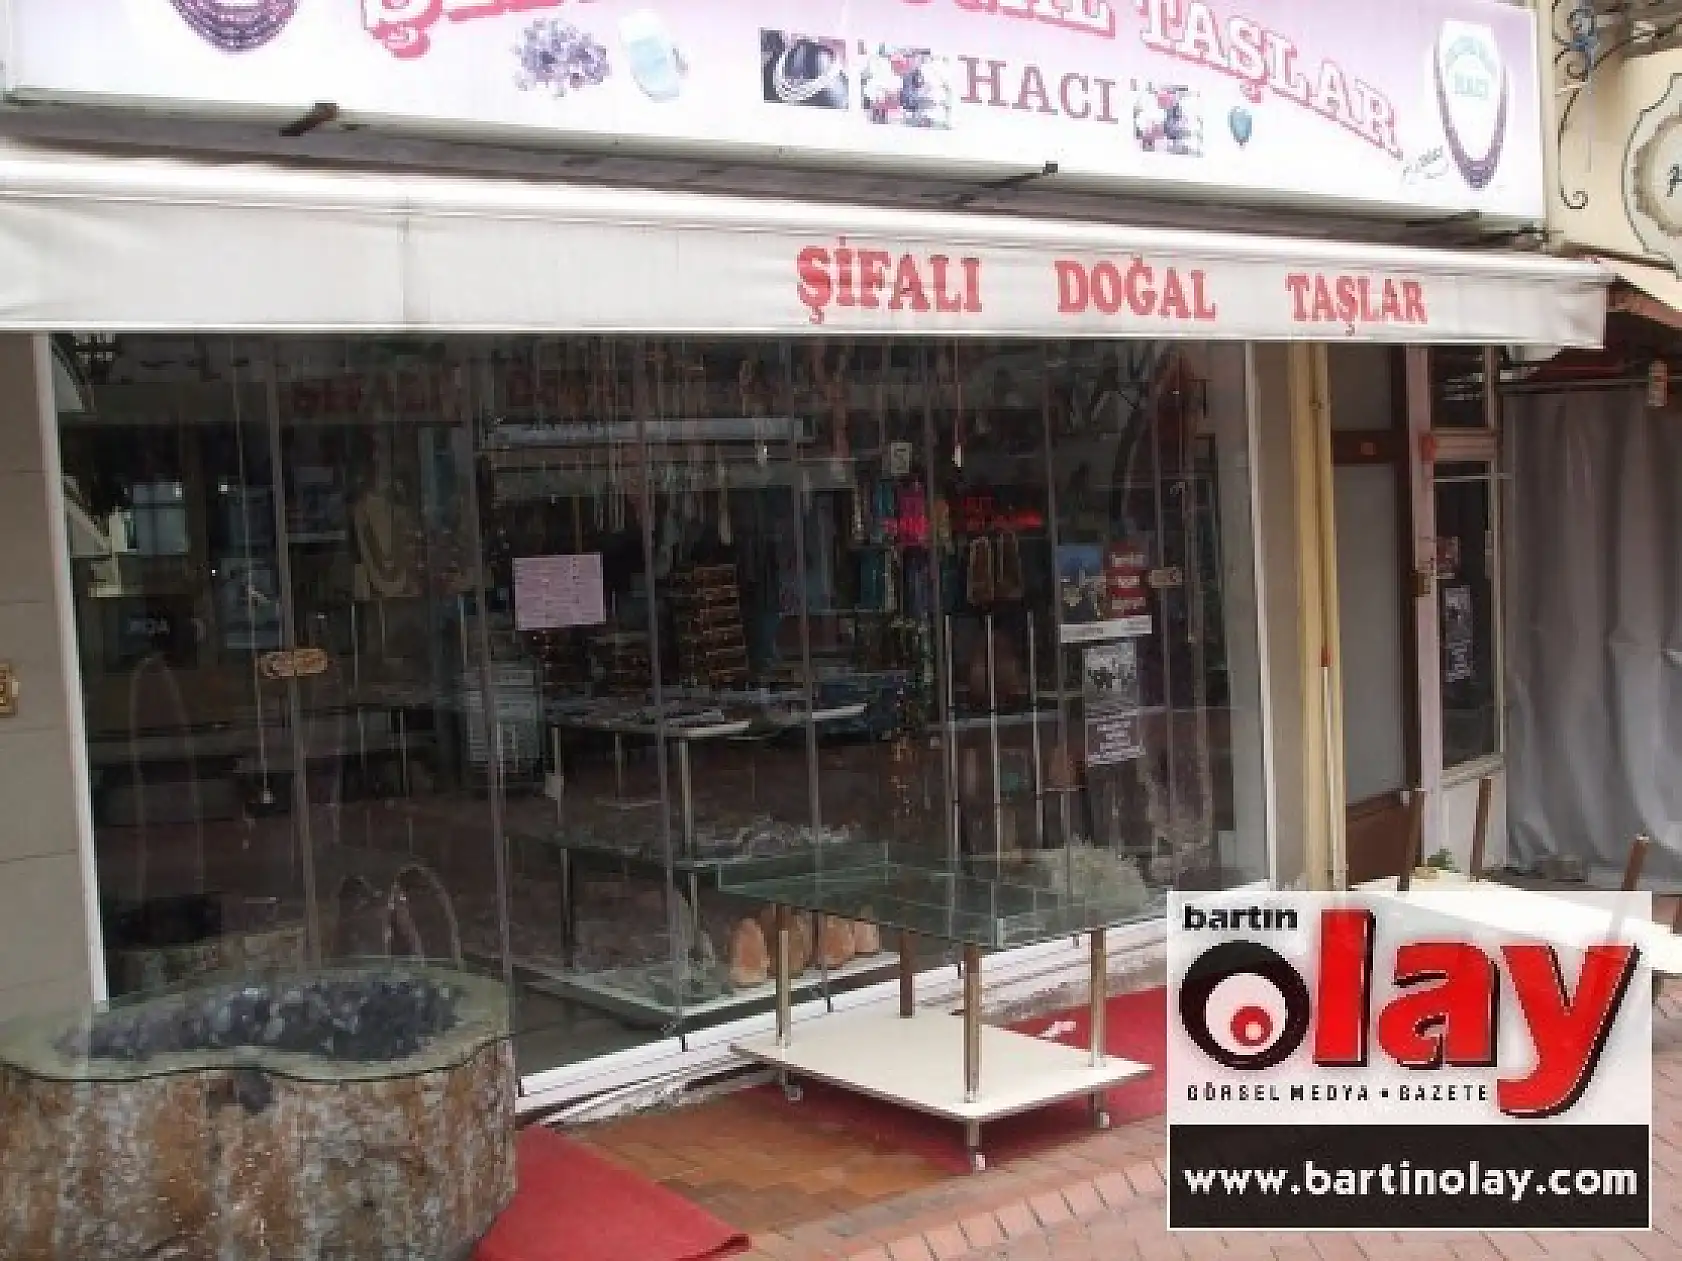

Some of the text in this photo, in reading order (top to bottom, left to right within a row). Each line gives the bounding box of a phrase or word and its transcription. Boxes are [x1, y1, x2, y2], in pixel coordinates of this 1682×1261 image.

[957, 54, 1119, 125] HACI
[796, 235, 1428, 336] ŞİFALI DOĞAL TAŞLAR
